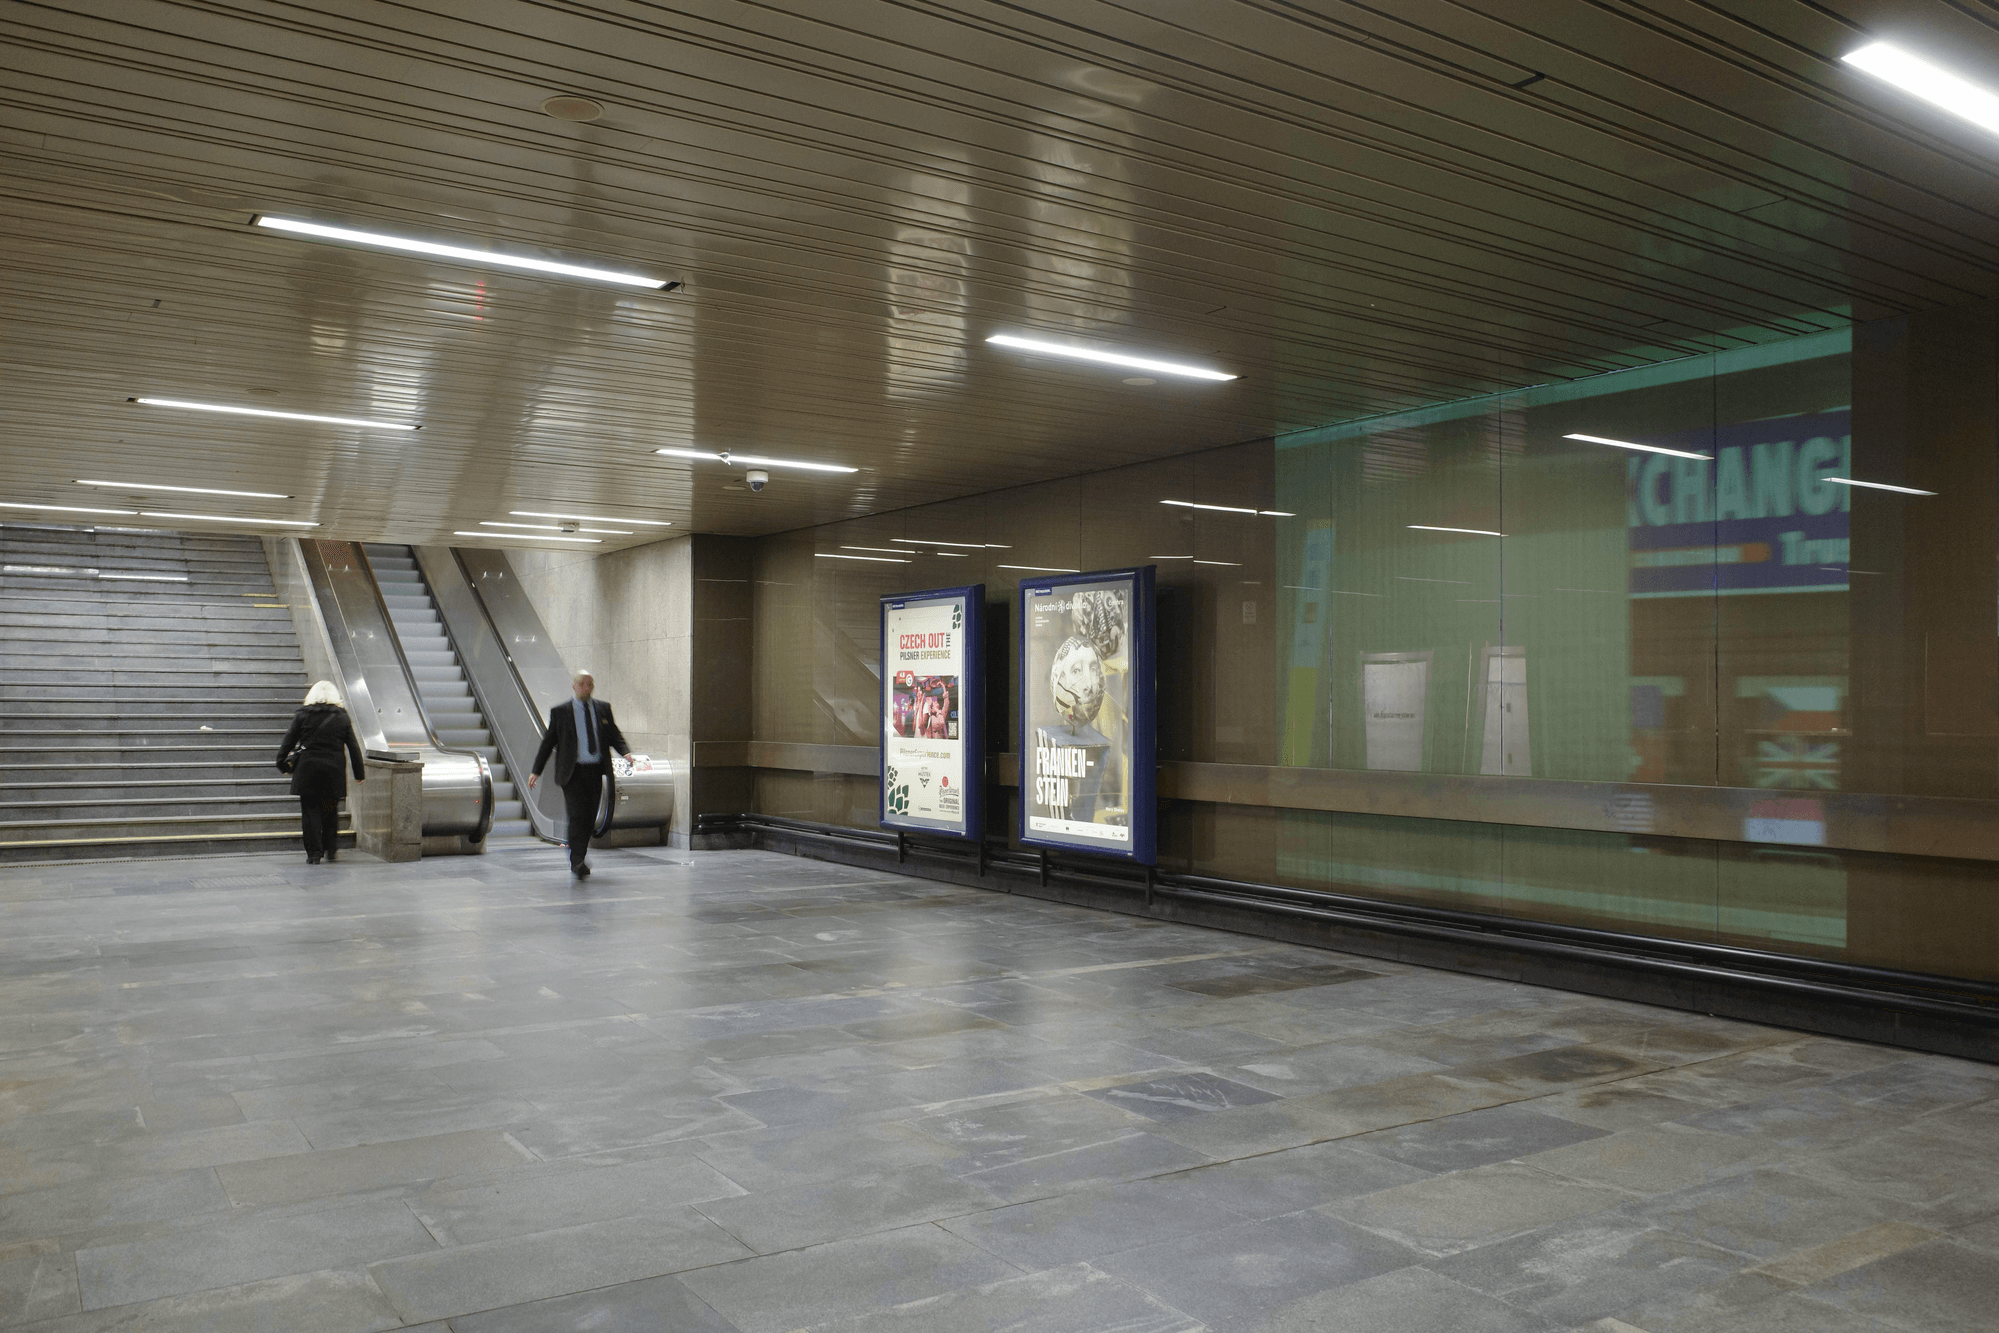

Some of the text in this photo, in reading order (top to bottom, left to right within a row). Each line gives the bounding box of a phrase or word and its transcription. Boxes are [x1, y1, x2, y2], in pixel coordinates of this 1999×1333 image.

[1628, 435, 1850, 528] CHANG
[900, 632, 945, 650] CZECH OUT
[900, 650, 951, 661] PILSNER EXPERIENCE
[1036, 747, 1094, 778] FRANKEN-
[1036, 777, 1068, 807] STEIN
